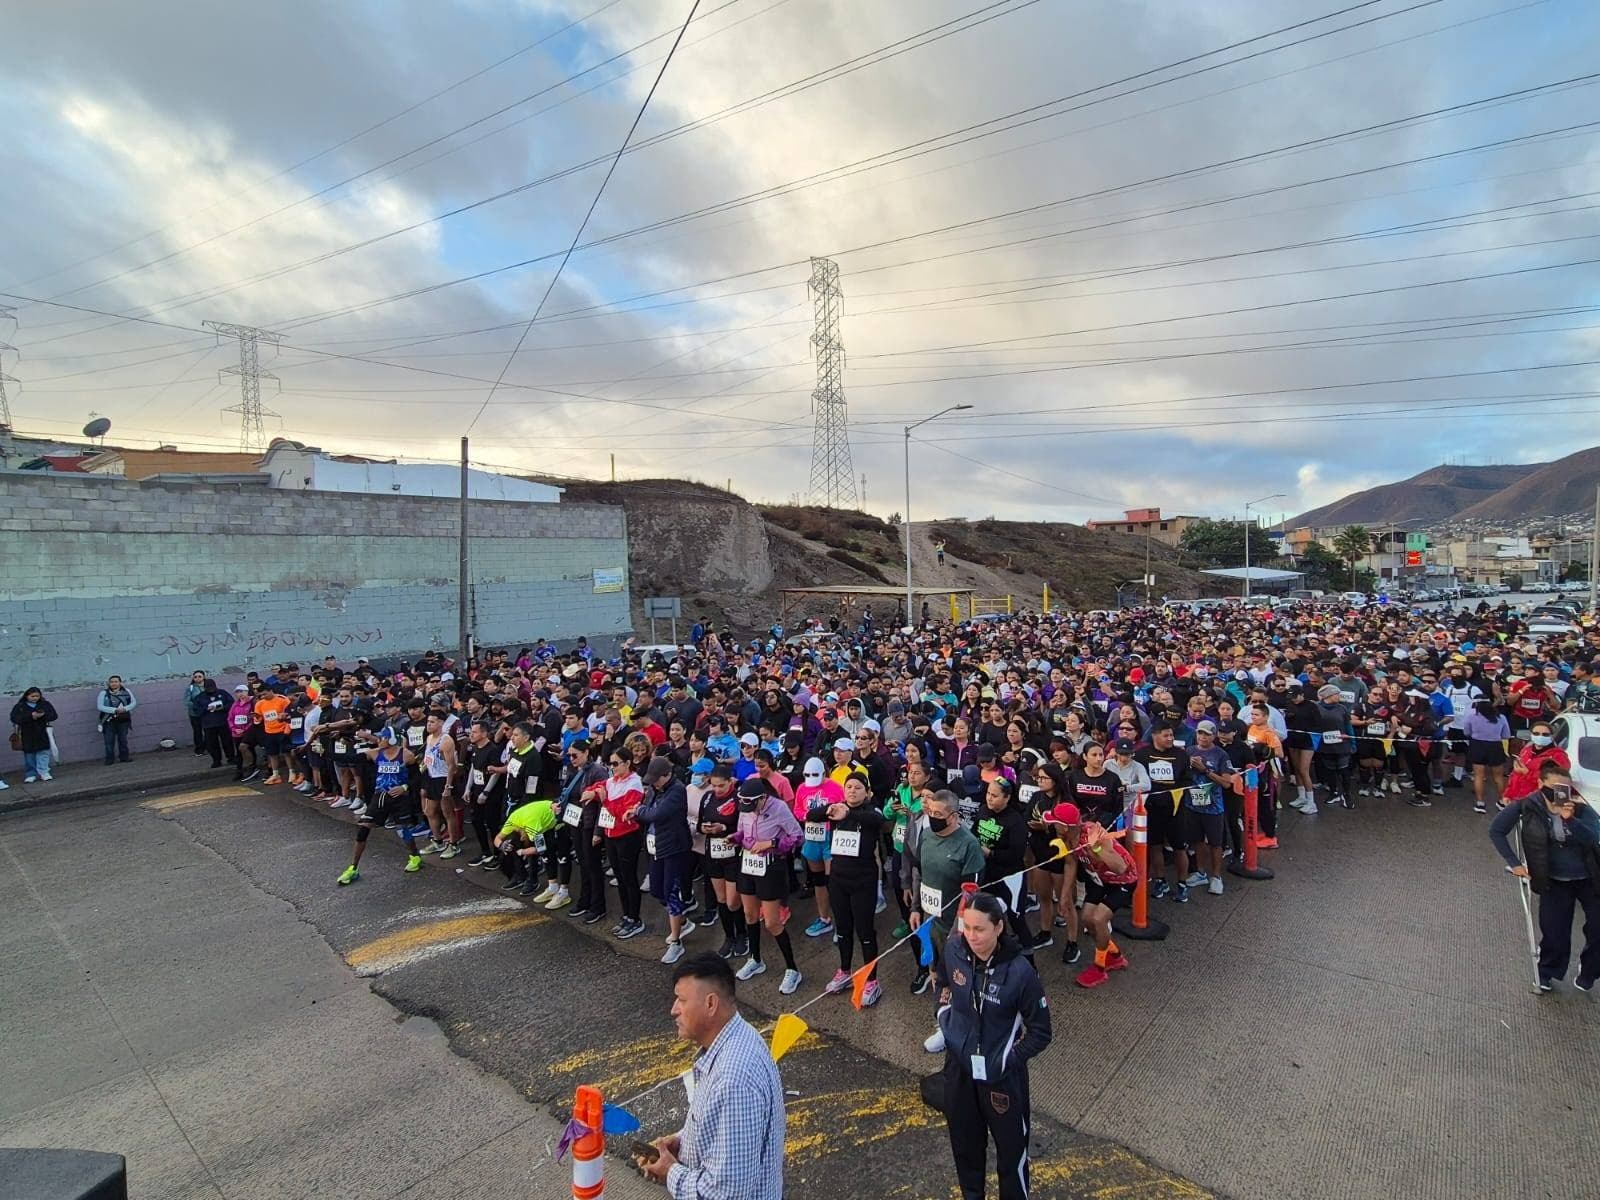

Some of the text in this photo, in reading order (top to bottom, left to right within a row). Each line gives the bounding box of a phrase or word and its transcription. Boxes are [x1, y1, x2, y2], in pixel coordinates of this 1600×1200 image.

[1150, 767, 1171, 776] 4700
[806, 826, 825, 836] 0565
[833, 838, 858, 849] 1202
[744, 858, 765, 875] 1868
